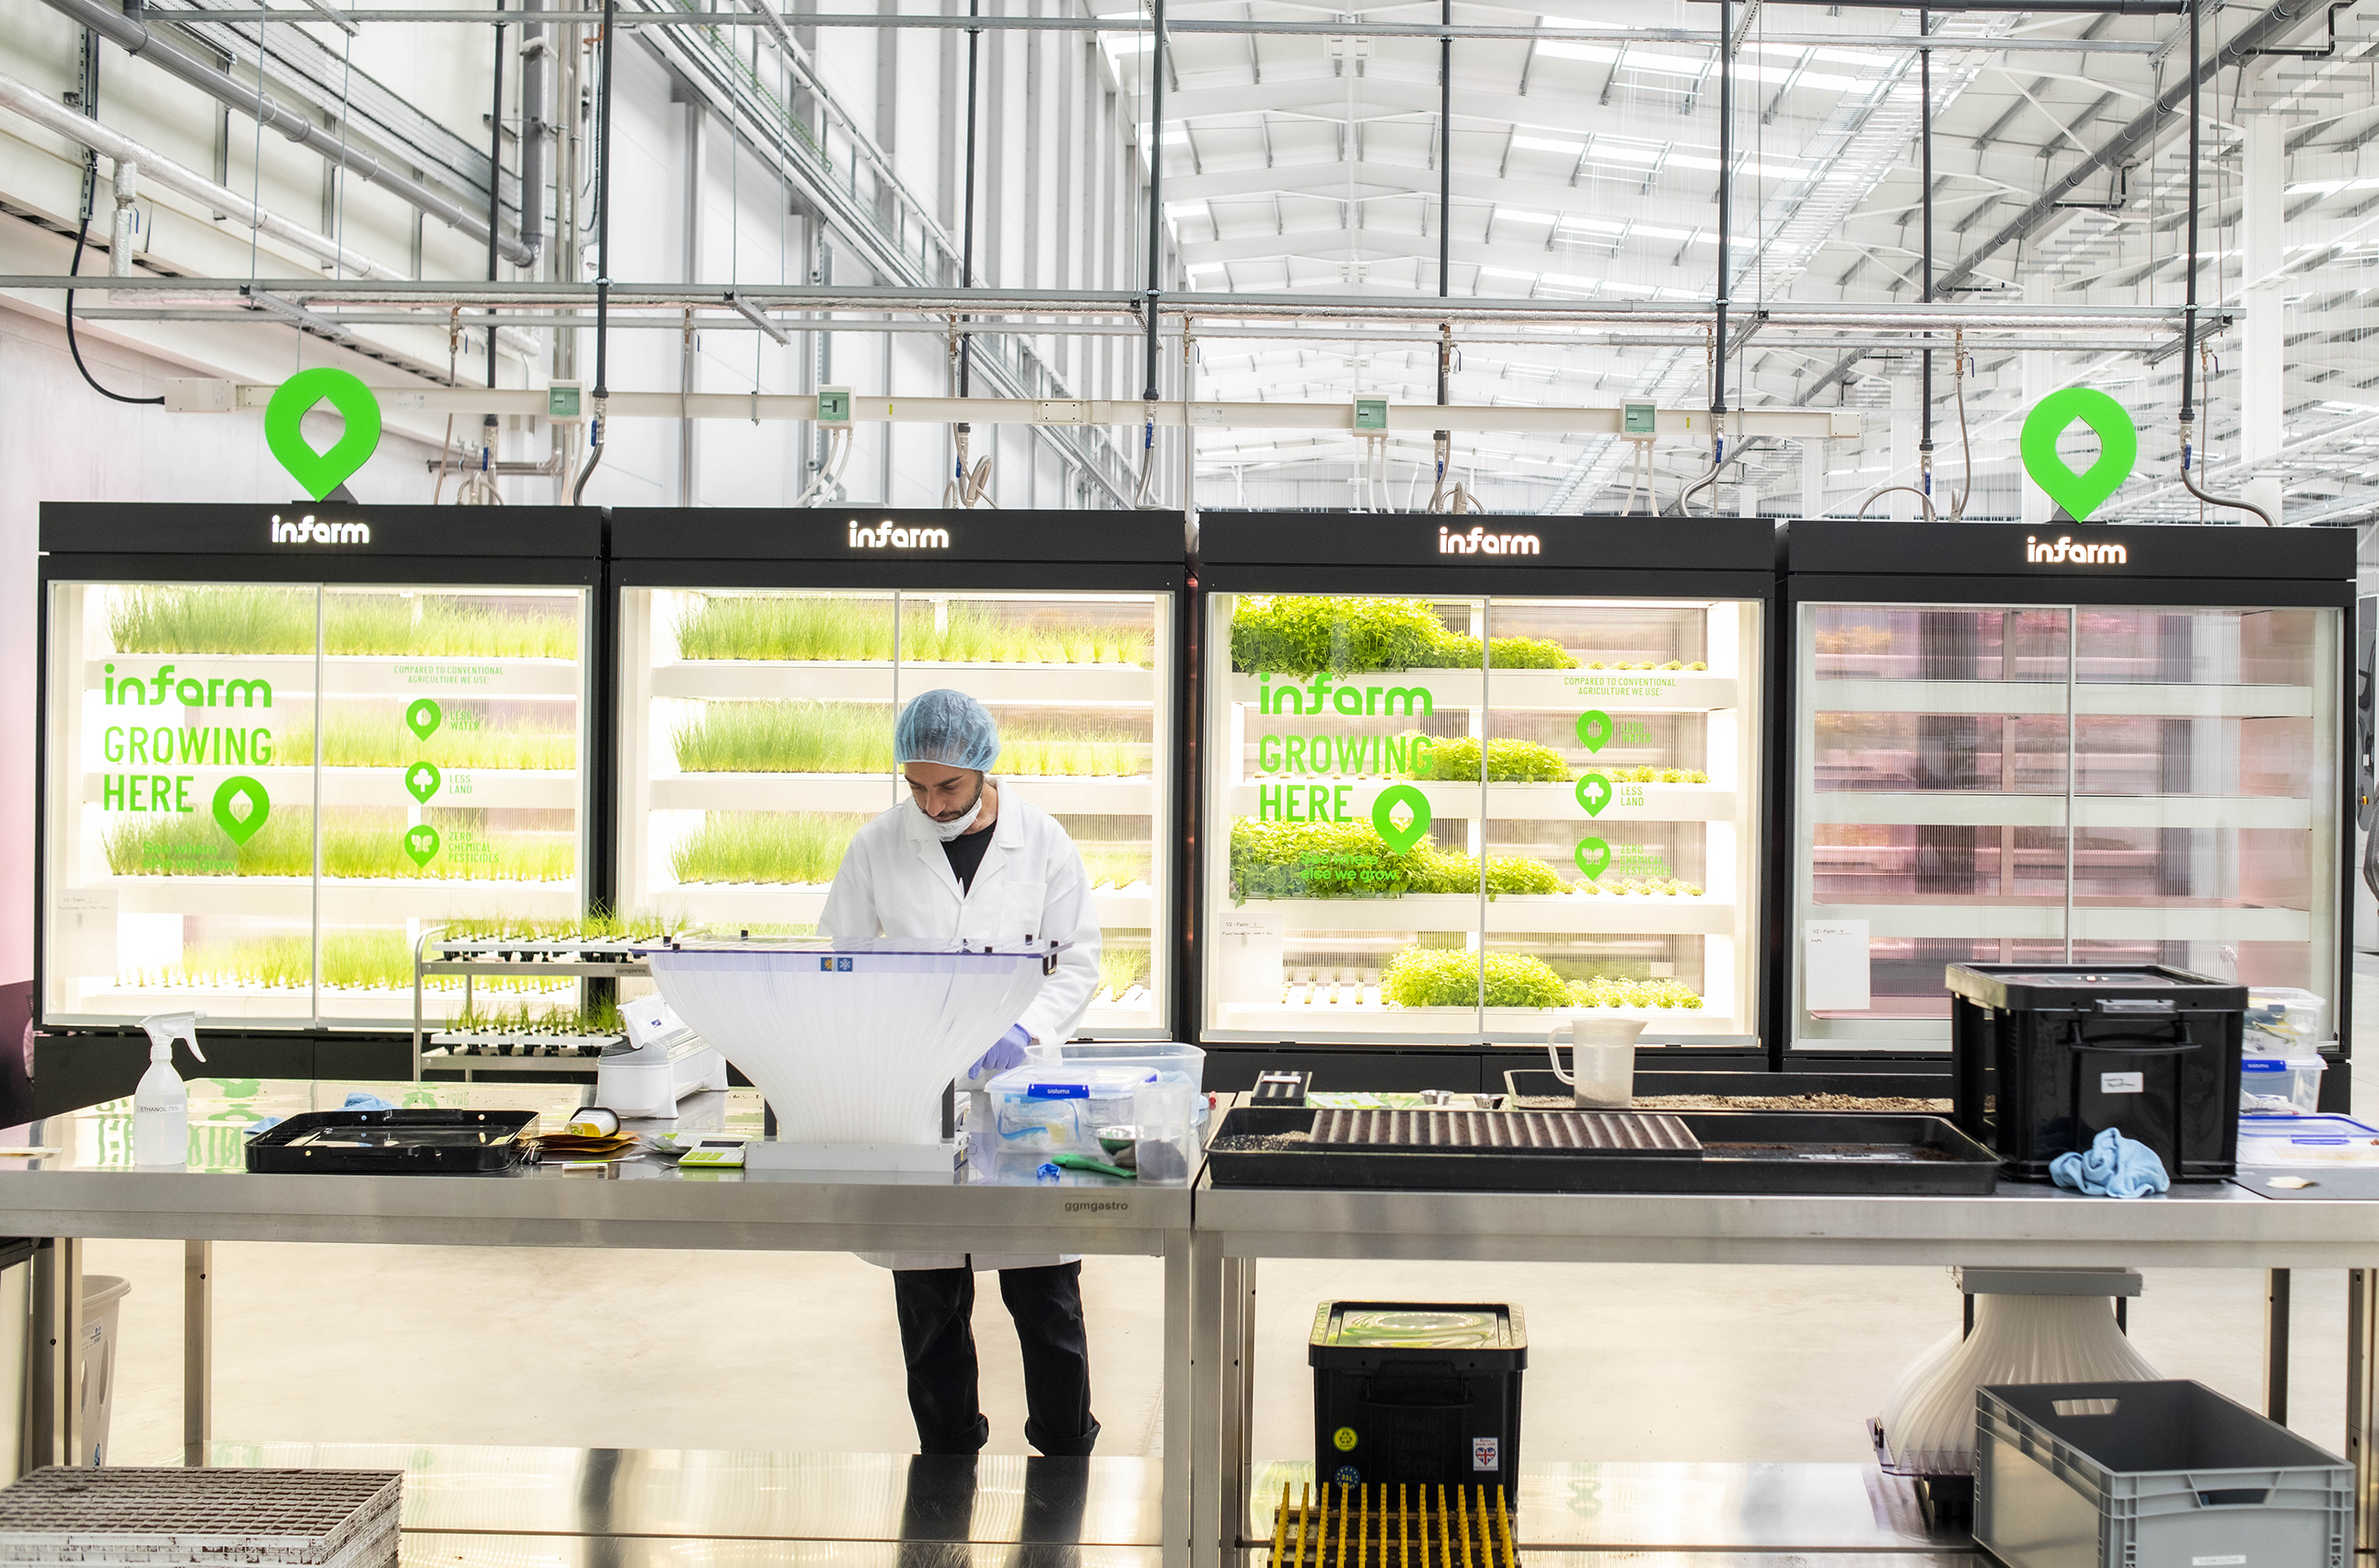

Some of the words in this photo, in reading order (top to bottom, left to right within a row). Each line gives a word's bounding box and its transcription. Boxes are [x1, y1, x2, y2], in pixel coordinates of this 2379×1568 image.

[271, 514, 370, 544] infarm
[849, 520, 950, 548] infarm
[1439, 525, 1541, 555] infarm
[2027, 536, 2127, 564] infarm
[394, 665, 433, 674] COMPARED
[436, 666, 445, 674] TO
[447, 666, 503, 675] CONVENTIONAL
[104, 663, 272, 708] infarm
[408, 675, 458, 684] AGRICULTURE
[460, 675, 471, 684] WE
[473, 676, 491, 685] USE:
[1565, 676, 1605, 686] COMPARED
[1607, 677, 1617, 686] TO
[1618, 677, 1676, 687] CONVENTIONAL
[1260, 672, 1433, 717] infarm
[1577, 686, 1630, 696] AGRICULTURE
[1632, 687, 1644, 696] WE
[1646, 687, 1663, 697] USE:
[450, 710, 472, 721] LESS
[450, 721, 479, 731] WATER
[1622, 722, 1644, 732] LESS
[1622, 733, 1652, 743] WATER
[104, 726, 271, 766] GROWING
[1259, 734, 1433, 775] GROWING
[449, 774, 471, 783] LESS
[103, 774, 195, 813] HERE
[449, 785, 472, 794] LAND
[1621, 787, 1643, 796] LESS
[1259, 784, 1354, 823] HERE
[1621, 797, 1645, 807] LAND
[448, 832, 472, 842] ZERO
[143, 842, 171, 855] See
[174, 843, 218, 856] where
[448, 843, 491, 853] CHEMICAL
[1621, 845, 1644, 854] ZERO
[143, 858, 172, 870] else
[175, 859, 196, 870] we
[448, 853, 500, 864] PESTICIDES
[1300, 852, 1330, 865] See
[1333, 853, 1379, 866] where
[1620, 856, 1664, 866] CHEMICAL
[1300, 867, 1332, 880] else
[1334, 869, 1357, 880] we
[1359, 869, 1401, 883] grow.
[1620, 867, 1672, 876] PESTICIDES
[1065, 1202, 1128, 1212] ggmgastro
